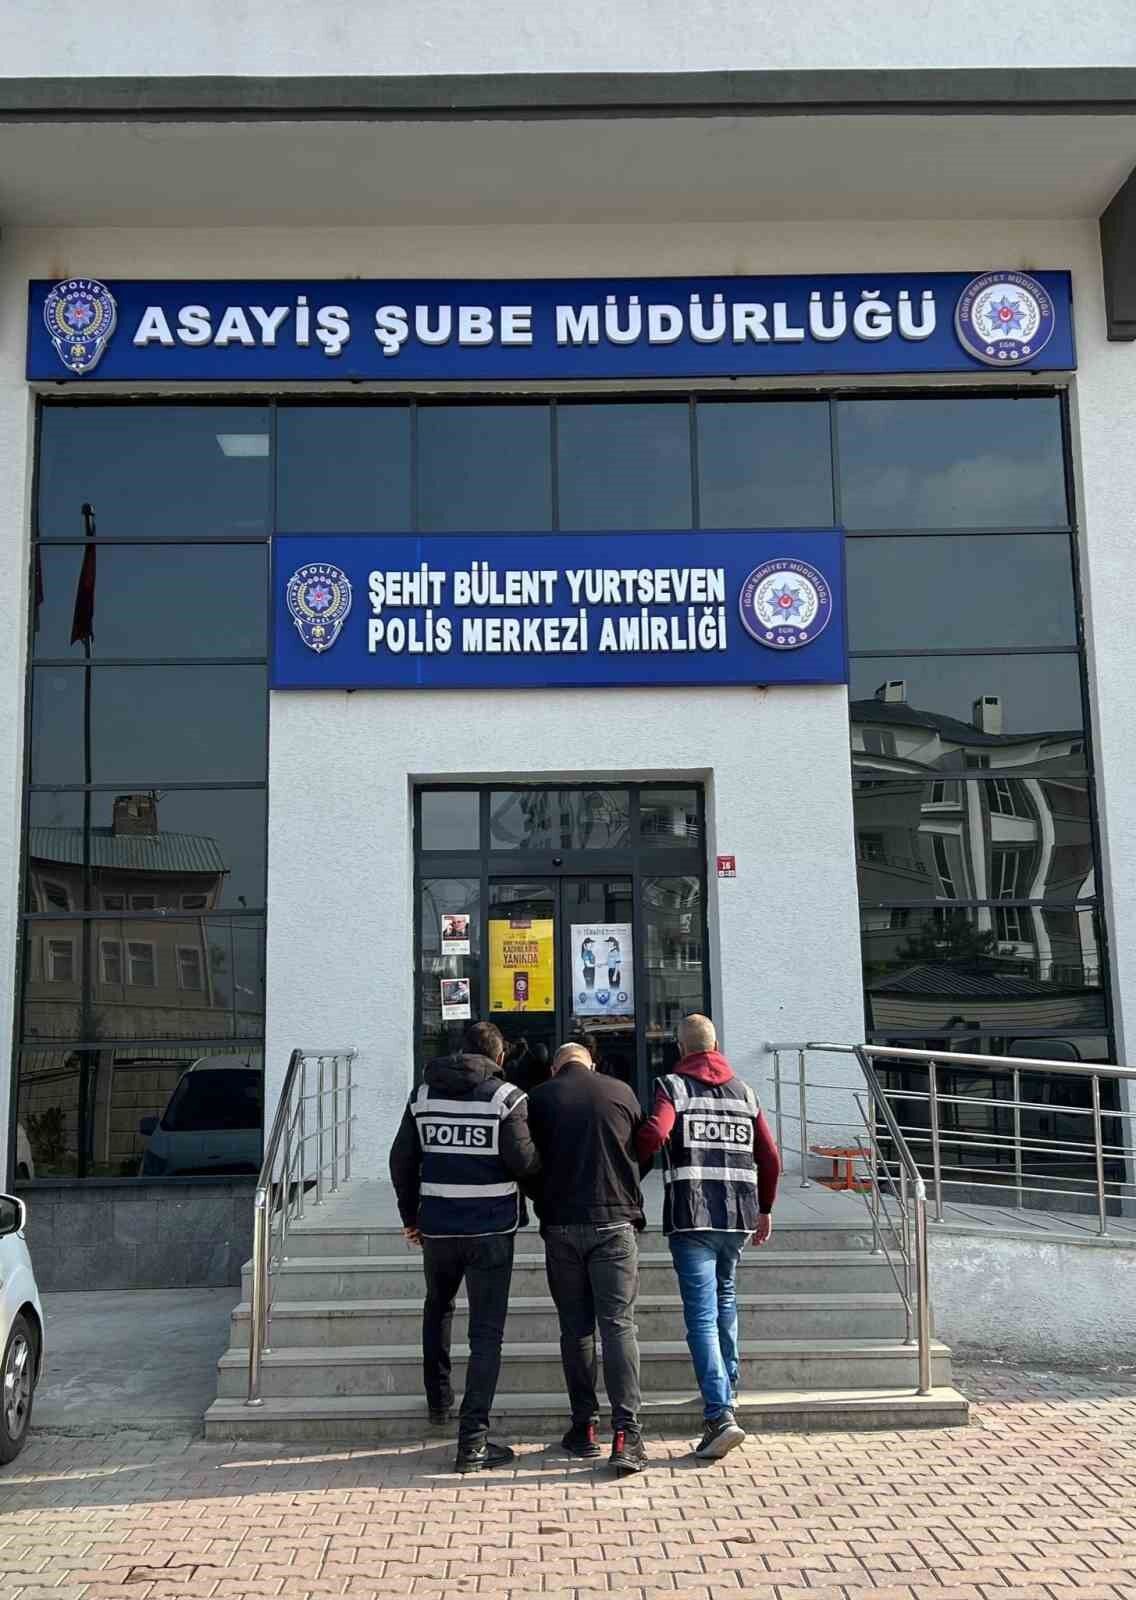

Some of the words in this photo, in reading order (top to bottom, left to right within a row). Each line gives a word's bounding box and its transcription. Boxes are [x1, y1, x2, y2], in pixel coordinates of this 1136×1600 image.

[134, 295, 351, 356] ASAYİŞ
[375, 305, 534, 356] ŞUBE
[556, 290, 938, 344] MÜDÜRLÜĞÜ
[368, 562, 446, 615] ŞEHİT
[453, 561, 558, 606] BÜLENT
[565, 568, 726, 605] YURTSEVEN
[368, 609, 452, 653] POLİS
[462, 607, 589, 653] MERKEZİ
[599, 606, 728, 652] AMİRLİĞİ
